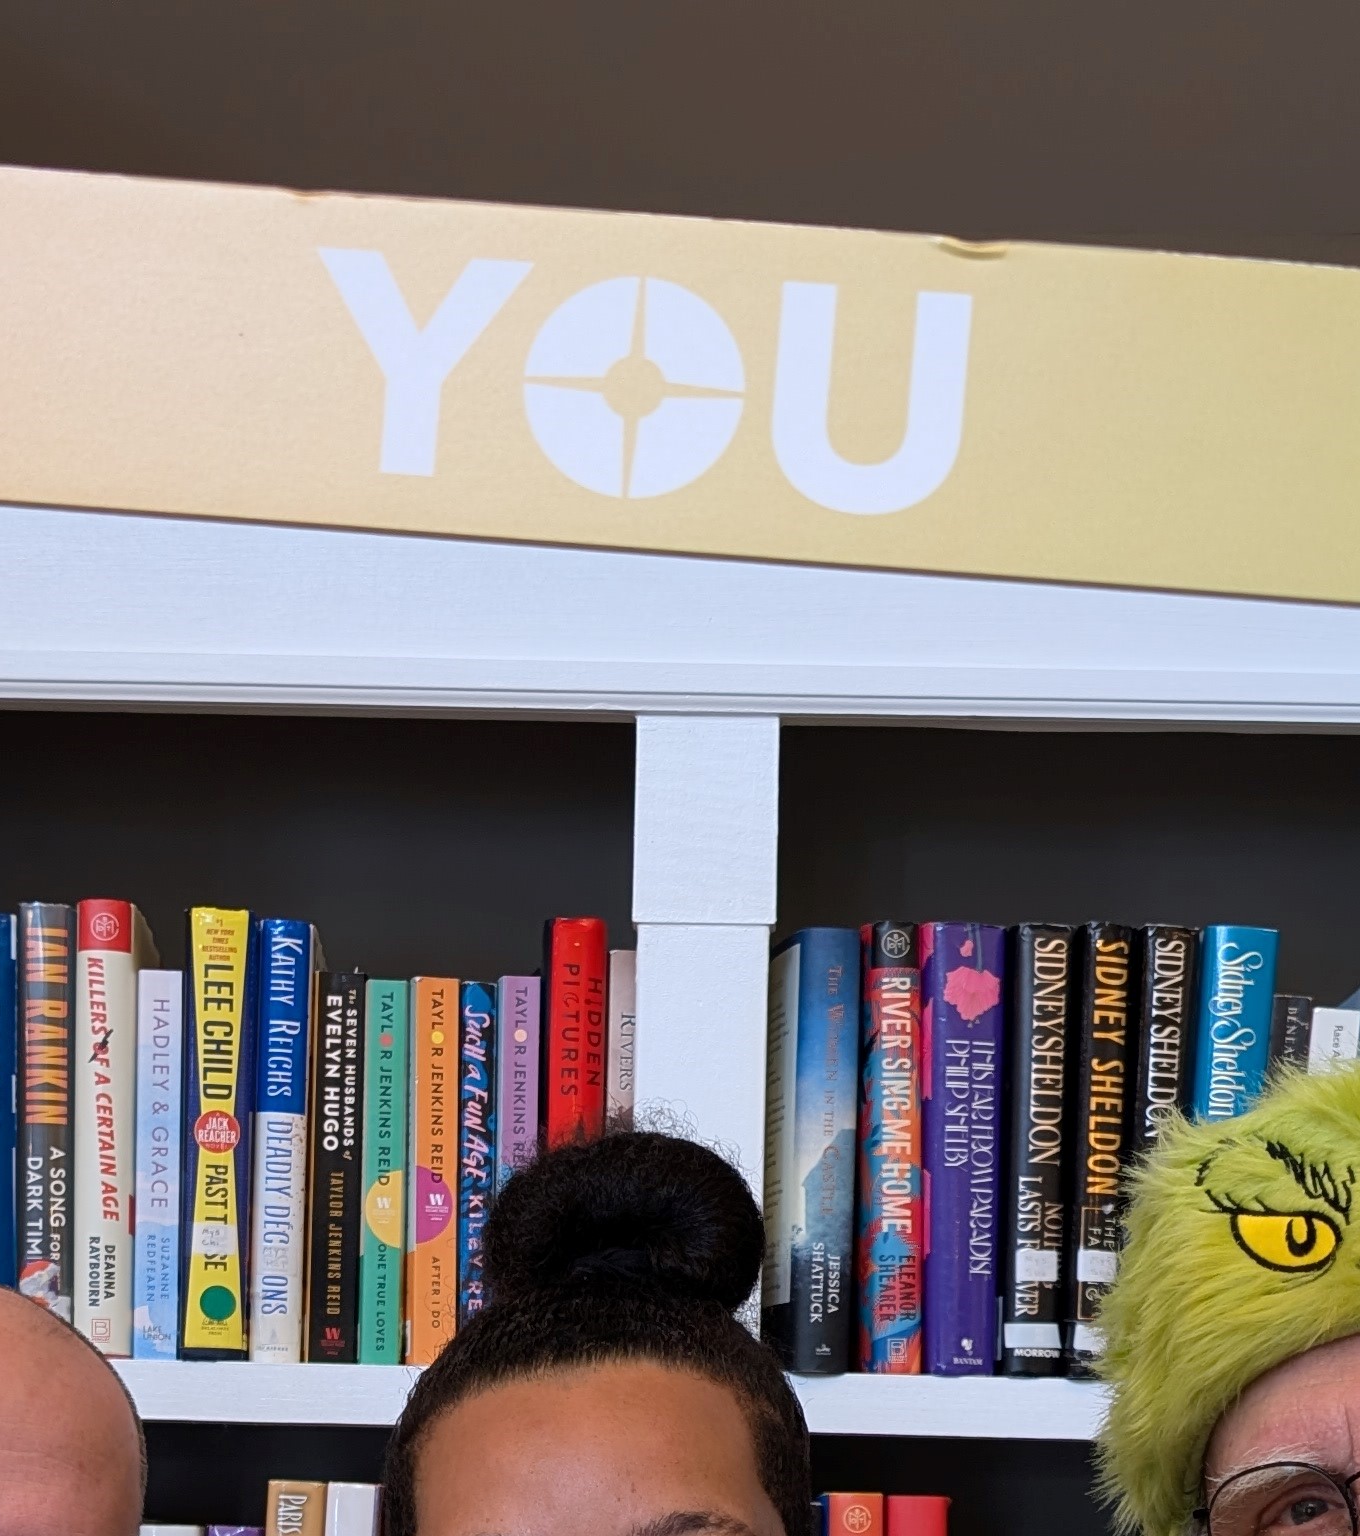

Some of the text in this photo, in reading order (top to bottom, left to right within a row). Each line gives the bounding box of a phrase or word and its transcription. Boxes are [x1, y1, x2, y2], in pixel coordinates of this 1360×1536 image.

[318, 247, 972, 515] YOU
[25, 927, 68, 1125] IAN RANKIN
[202, 964, 234, 1100] LEE CHILD
[267, 936, 303, 1097] KATHY REICHS
[323, 995, 343, 1152] EVELYN HUGO
[560, 964, 581, 1096] PICTURES
[585, 978, 603, 1087] HIDDEN
[618, 1012, 635, 1092] RIVERS
[1028, 937, 1066, 1167] SIDNEY SHELDON
[1086, 940, 1128, 1195] SIDNEY SHELDON
[151, 999, 169, 1209] HADLEY & GRACE
[198, 1131, 237, 1144] REACHER
[205, 1118, 230, 1131] JACK
[378, 1063, 392, 1186] JENKINS REID
[430, 1058, 444, 1184] JENKINS REID
[881, 976, 913, 1233] RIVER SING ME HOME
[88, 1236, 100, 1307] RAYBOURN
[102, 1244, 115, 1301] DEANNA
[146, 1234, 155, 1303] REDFEARN
[159, 1237, 169, 1301] SUZANNE
[809, 1242, 825, 1323] SHATTUCK
[827, 1254, 840, 1314] JESSICA
[897, 1254, 917, 1322] ELEANOR
[1013, 1346, 1060, 1358] MORROW
